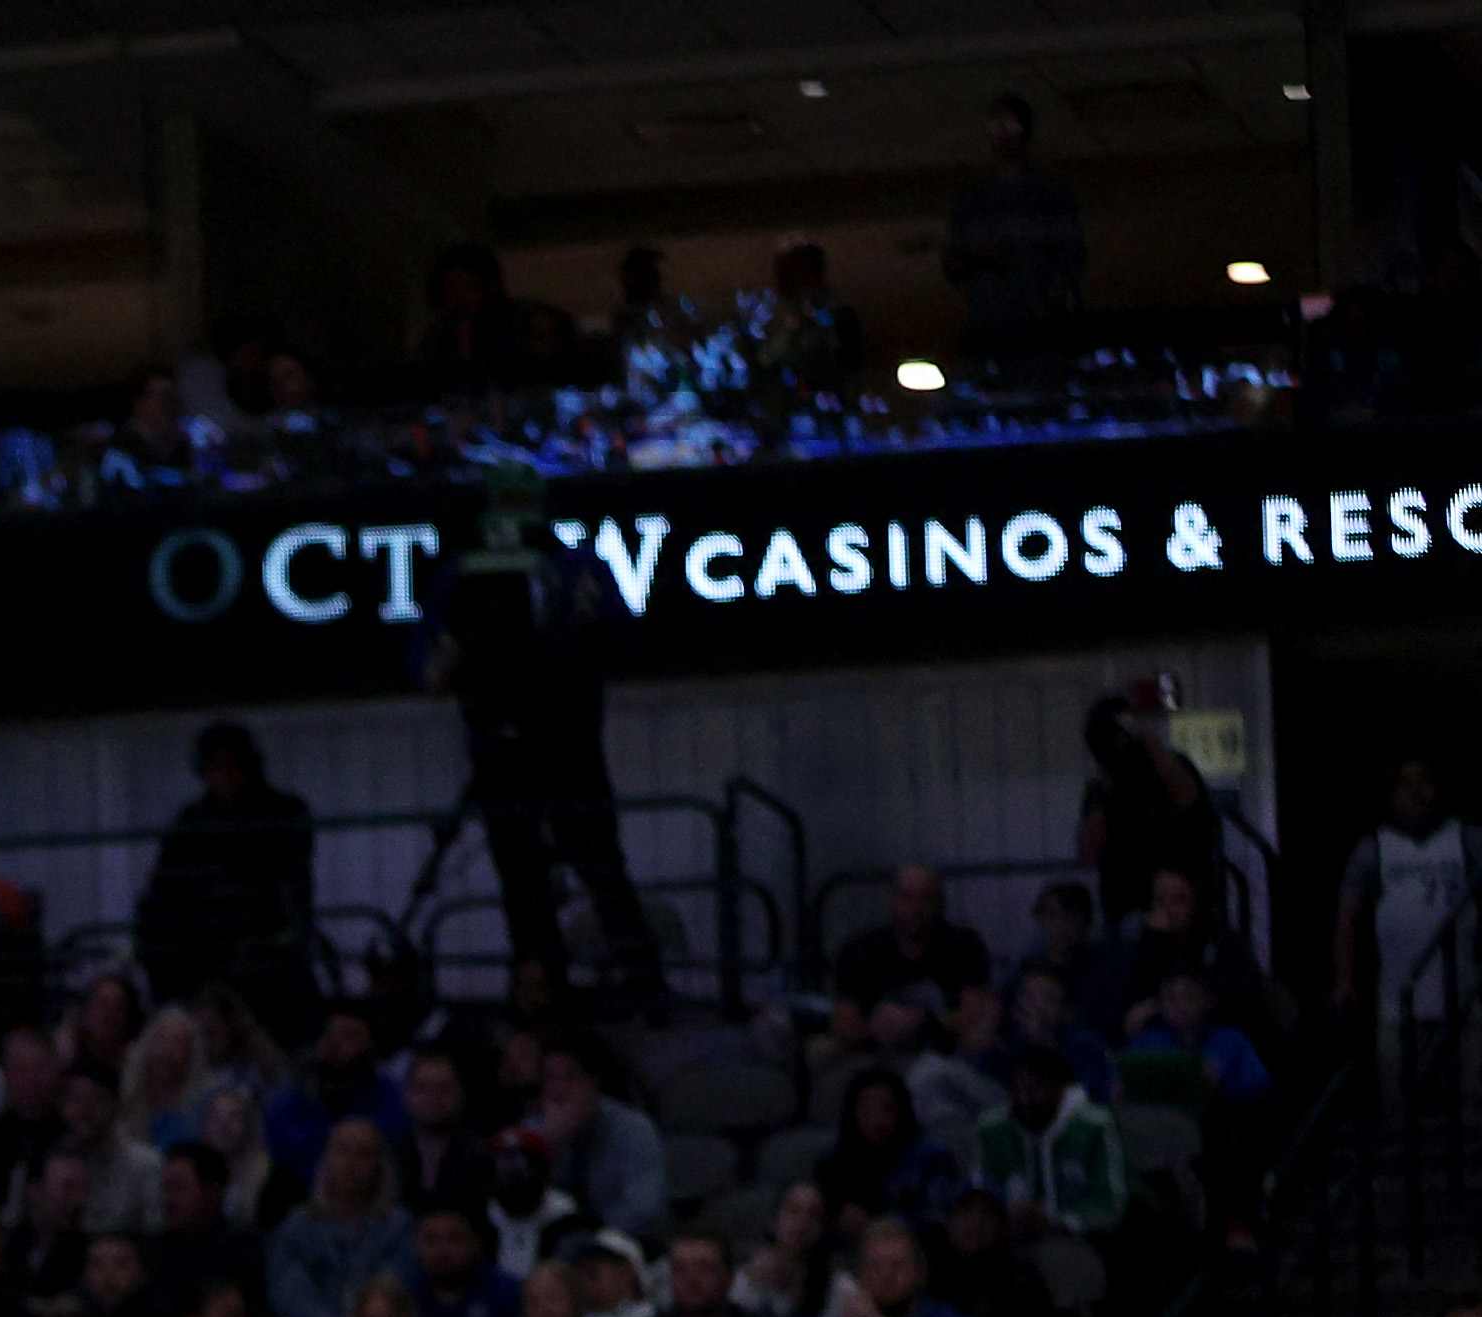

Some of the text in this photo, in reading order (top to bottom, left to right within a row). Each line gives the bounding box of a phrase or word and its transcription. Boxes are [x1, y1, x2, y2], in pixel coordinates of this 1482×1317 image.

[147, 512, 672, 626] OCTW
[684, 505, 1124, 602] CASINOS
[1166, 498, 1225, 573] &
